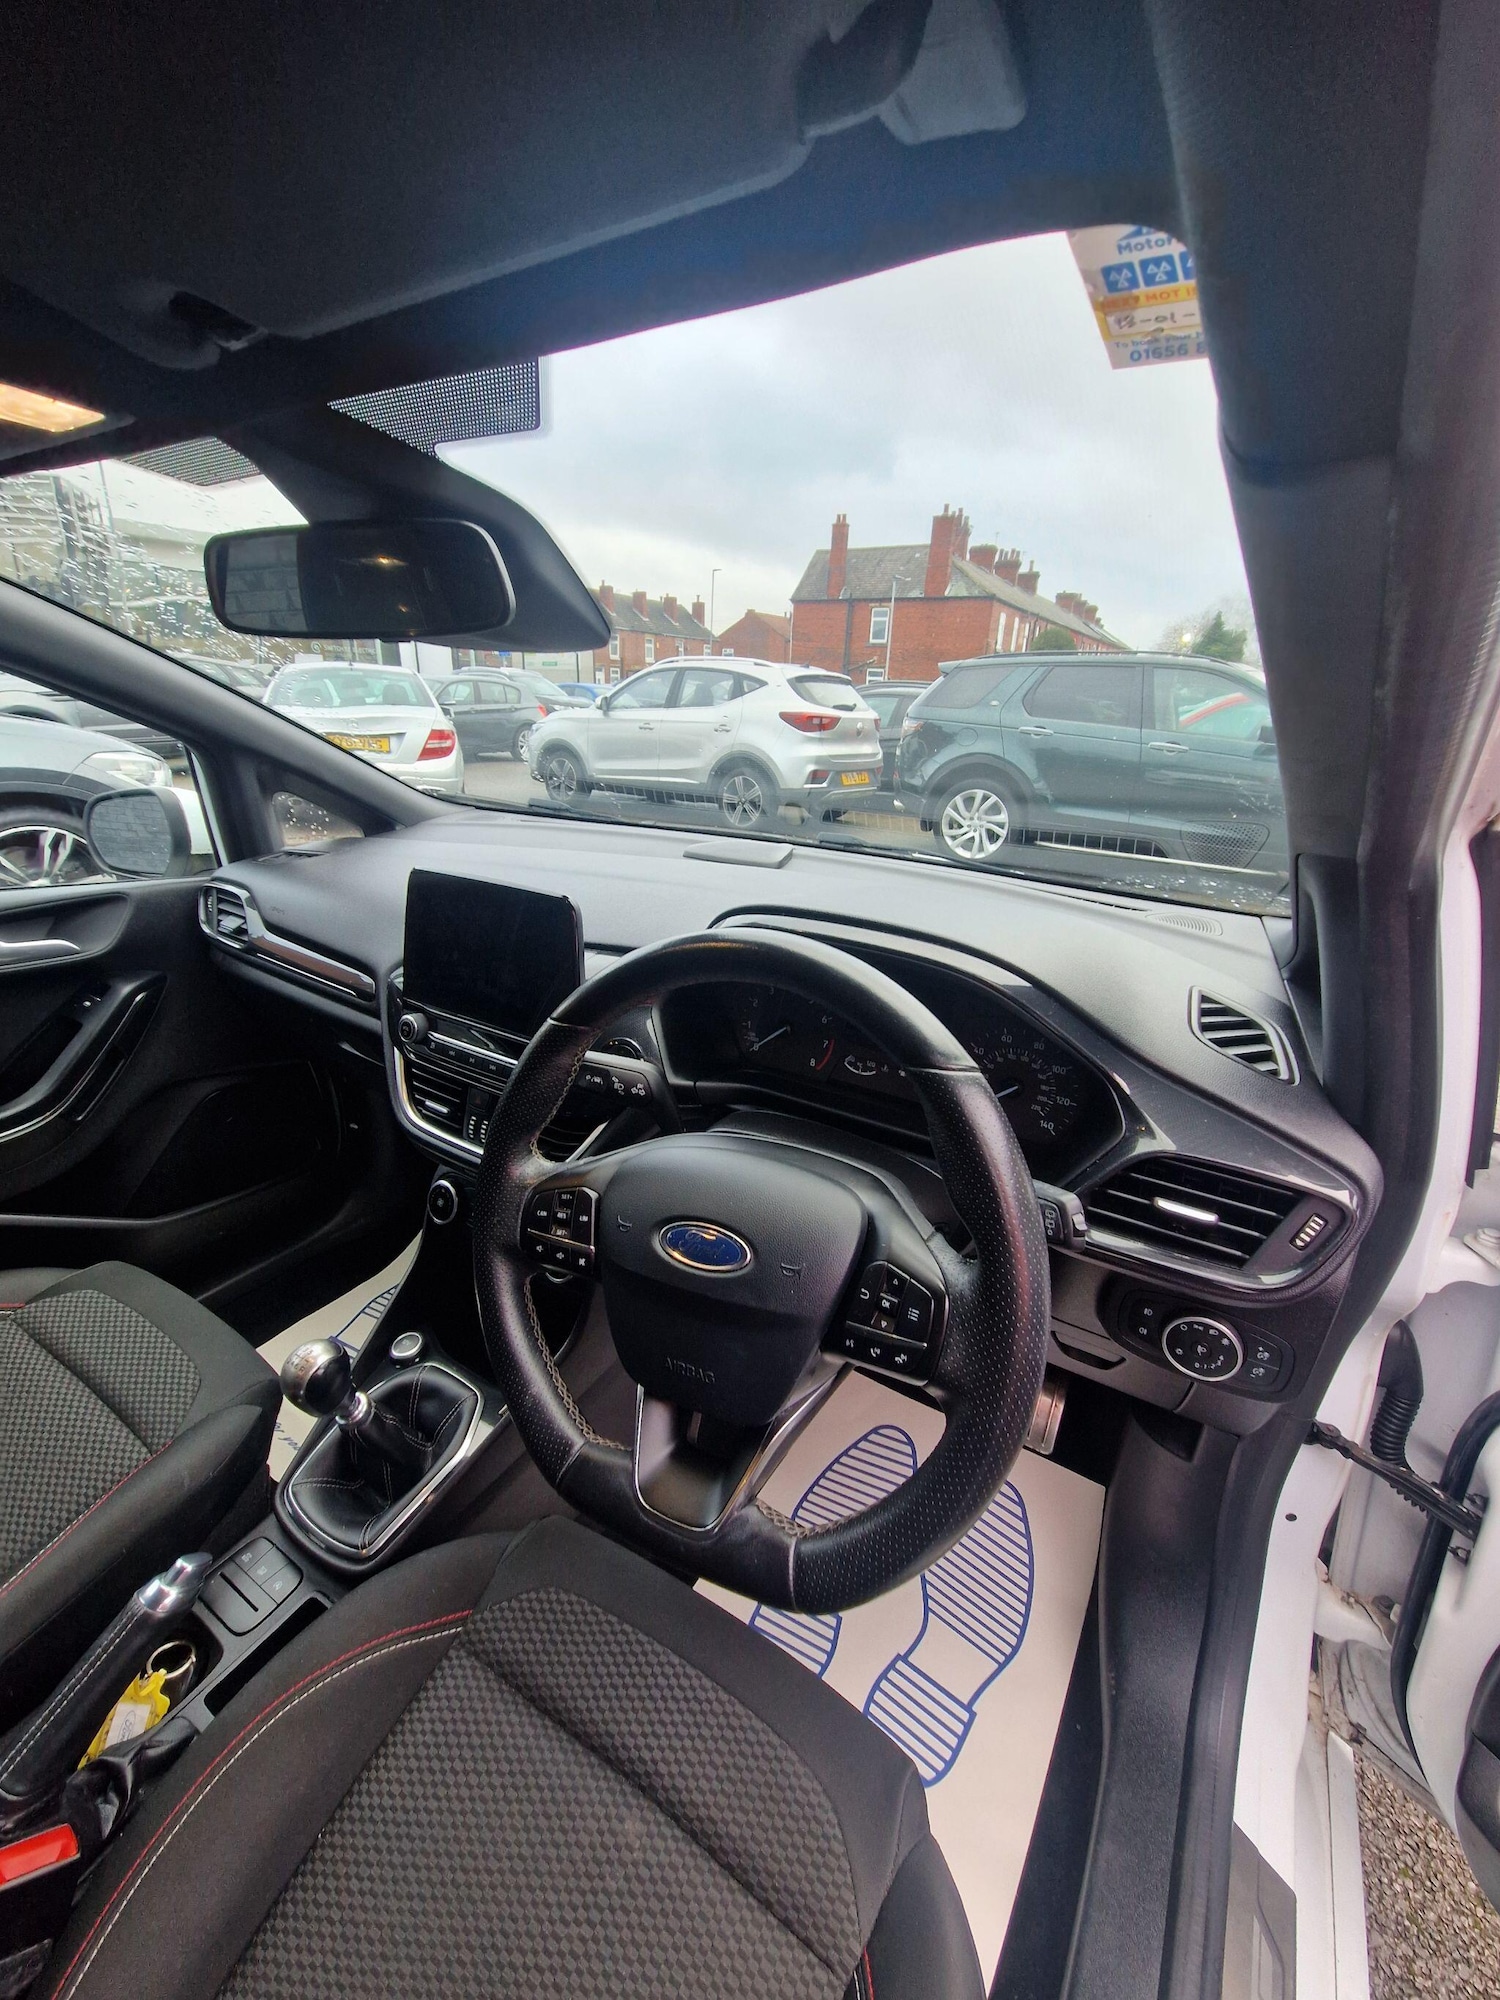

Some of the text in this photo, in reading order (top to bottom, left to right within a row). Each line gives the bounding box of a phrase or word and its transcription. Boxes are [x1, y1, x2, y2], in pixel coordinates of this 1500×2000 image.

[1117, 235, 1173, 256] Motor
[1145, 289, 1181, 302] MOT
[1129, 343, 1190, 363] 01656
[1001, 1034, 1013, 1043] 60
[973, 1047, 985, 1055] 40
[1033, 1041, 1045, 1051] 80
[1052, 1064, 1067, 1075] 100
[1056, 1096, 1071, 1106] 120
[1039, 1120, 1055, 1130] 140
[536, 1209, 548, 1217] CAN
[677, 1230, 731, 1262] Ford
[881, 1299, 891, 1309] OK
[665, 1355, 716, 1385] AIRBAG
